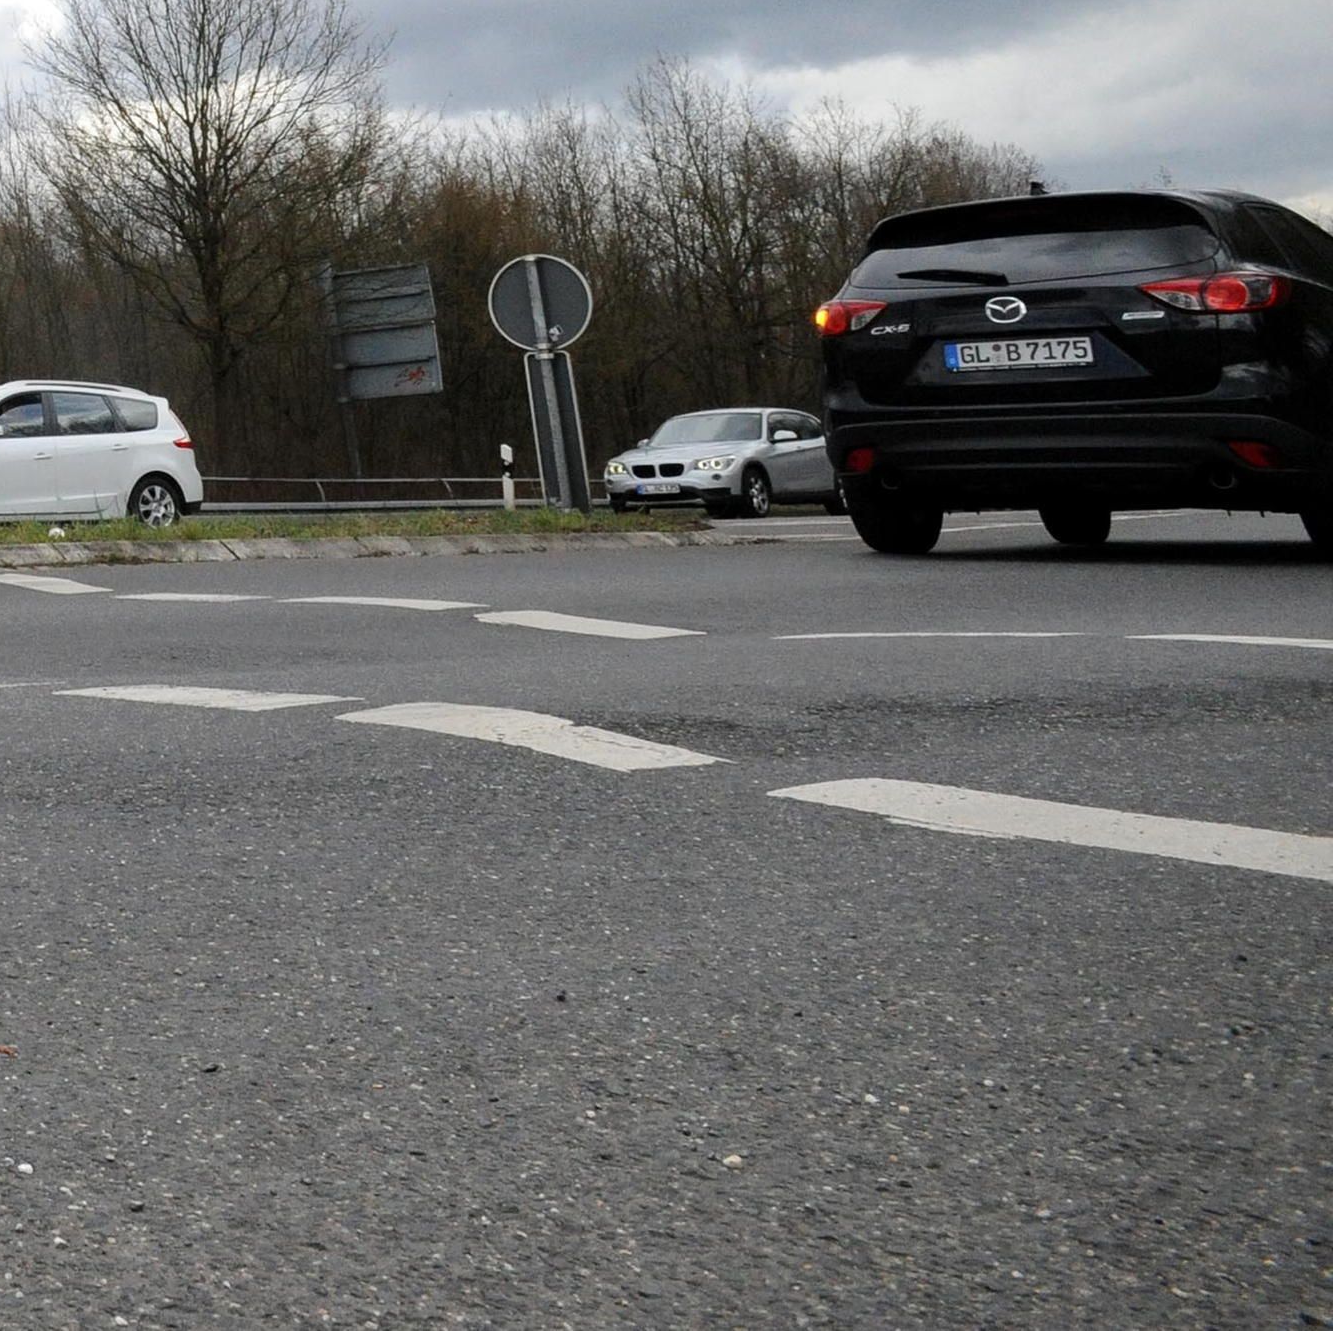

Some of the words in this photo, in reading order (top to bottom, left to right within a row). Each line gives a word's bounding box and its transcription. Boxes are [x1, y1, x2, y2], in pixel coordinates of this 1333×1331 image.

[871, 323, 910, 335] CX-5
[960, 345, 990, 364] GL
[1005, 343, 1022, 361] B
[1026, 340, 1088, 360] 7175
